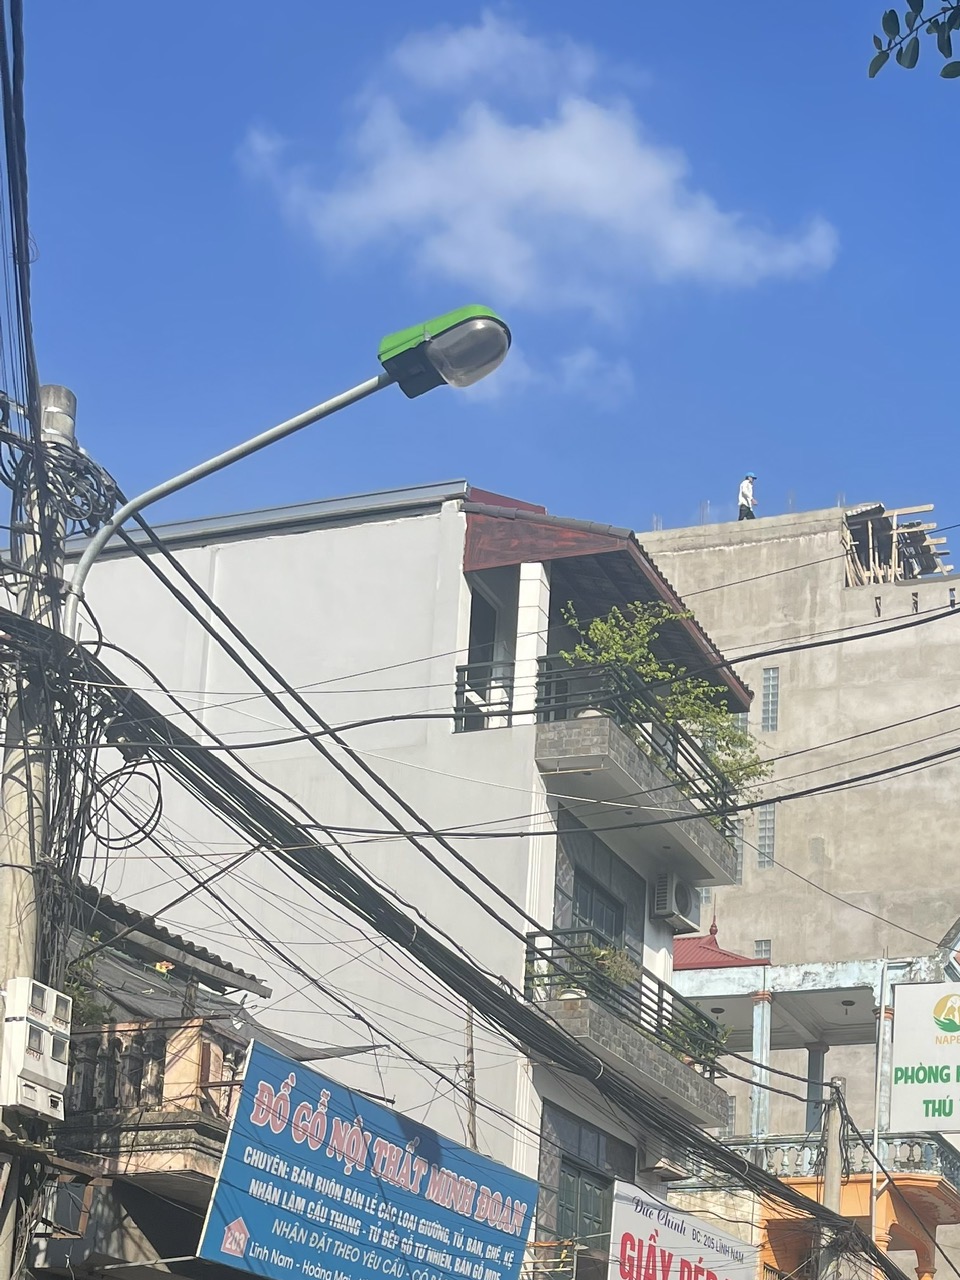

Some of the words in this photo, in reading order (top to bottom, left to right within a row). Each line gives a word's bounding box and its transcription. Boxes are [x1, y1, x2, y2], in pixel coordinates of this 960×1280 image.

[894, 1061, 951, 1085] PHÒNG
[923, 1095, 954, 1118] THÚ
[250, 1072, 297, 1134] ĐỒ
[292, 1088, 331, 1151] GỖ
[326, 1115, 372, 1175] NỘI
[370, 1136, 429, 1194] THẤT
[425, 1163, 478, 1217] MINH
[474, 1185, 528, 1237] ĐOAN
[243, 1146, 290, 1179] CHUYÊN:
[290, 1165, 314, 1190] BÁN
[315, 1174, 343, 1200] BUÔN
[343, 1186, 366, 1210] BÁN
[364, 1192, 378, 1215] LẺ
[377, 1200, 398, 1222] CÁC
[398, 1210, 418, 1233] LOẠI
[418, 1218, 451, 1246] GIƯỜNG,
[225, 1229, 245, 1252] 203
[249, 1178, 281, 1205] NHẬN
[281, 1189, 306, 1215] LÀM
[307, 1199, 329, 1223] CẦU
[329, 1210, 362, 1236] THANG
[368, 1220, 382, 1243] TỦ
[381, 1229, 400, 1249] BẾP
[401, 1234, 415, 1255] GỖ
[453, 1258, 472, 1278] BÁN
[249, 1241, 269, 1262] Lĩnh
[270, 1248, 294, 1270] Nam
[271, 1218, 308, 1245] NHẬN
[309, 1232, 333, 1254] ĐẶT
[332, 1240, 360, 1262] THEO
[362, 1250, 383, 1270] YÊU
[382, 1257, 405, 1278] CẦU
[703, 1234, 715, 1250] 205
[730, 1247, 744, 1264] NAM
